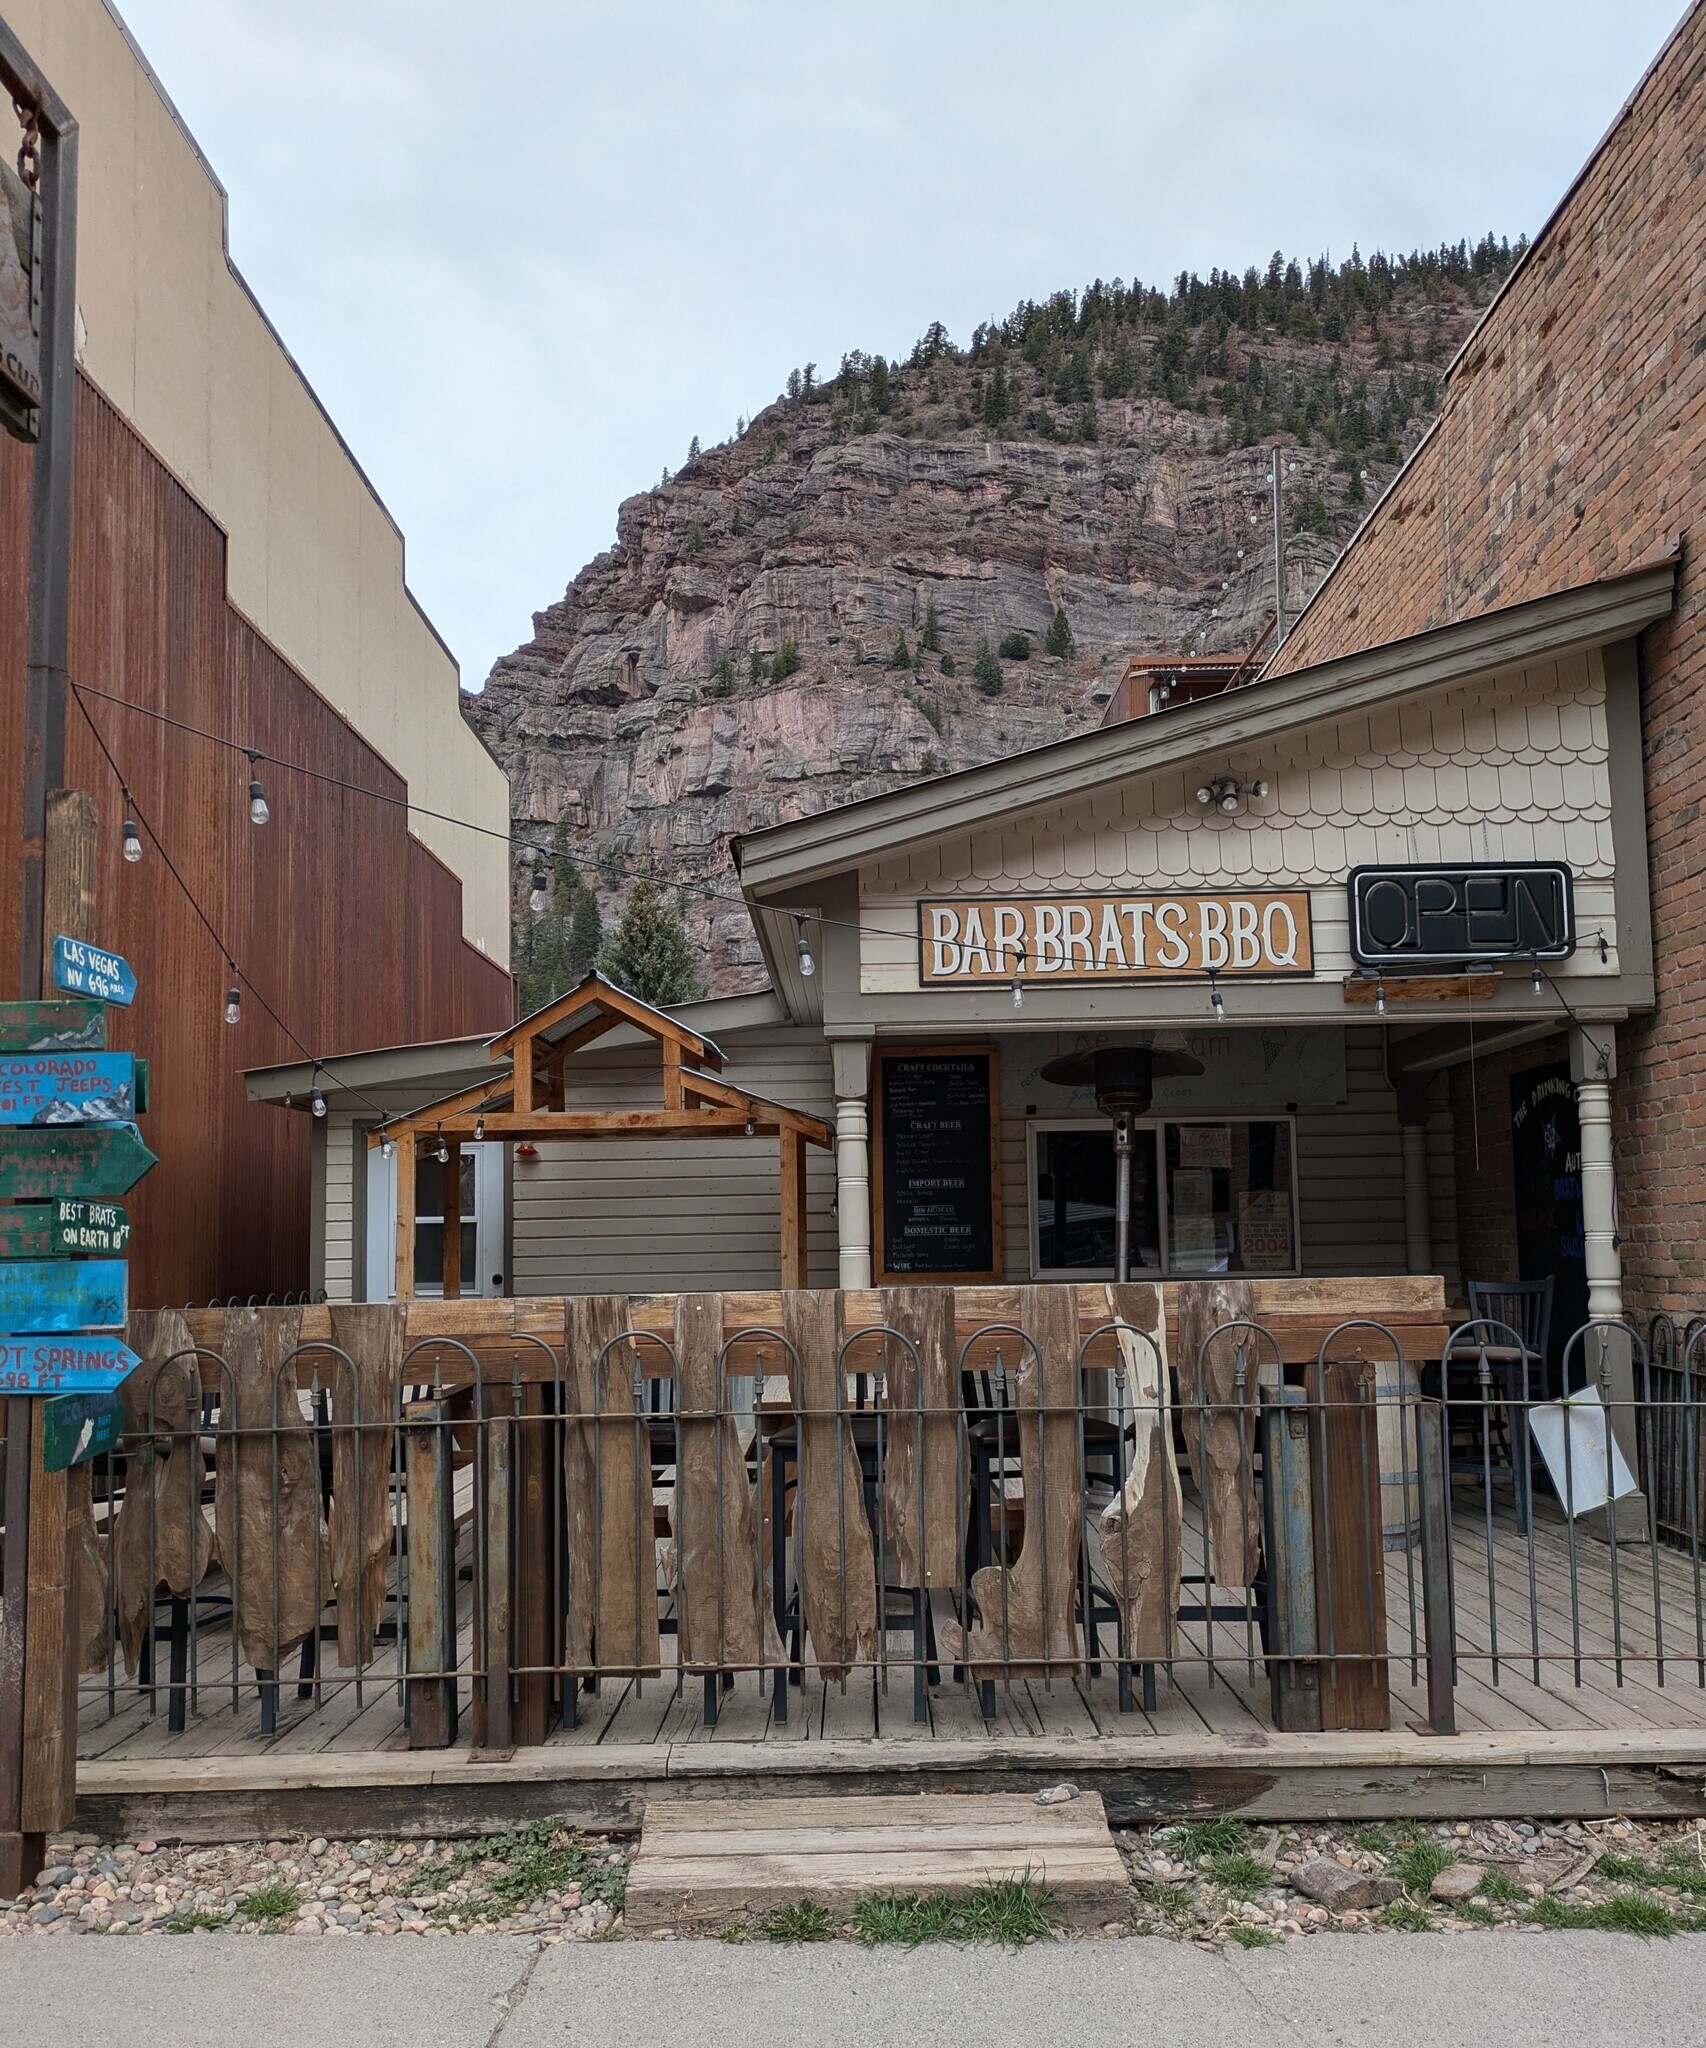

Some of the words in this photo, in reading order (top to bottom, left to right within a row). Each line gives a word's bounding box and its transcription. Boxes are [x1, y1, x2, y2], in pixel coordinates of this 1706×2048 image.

[1365, 879, 1558, 949] OPEN
[931, 907, 1025, 976] BAR
[1033, 902, 1189, 973] BRATS
[1197, 900, 1299, 969] BBQ
[64, 941, 85, 967] LAS
[88, 951, 120, 981] VEGAS
[67, 967, 83, 987] NV
[88, 973, 109, 997] 696
[110, 983, 125, 995] MILES
[897, 1063, 925, 1071] CRAFT
[926, 1063, 974, 1072] COCKTAILS
[0, 1079, 41, 1094] EST
[55, 1077, 112, 1094] JEEPS
[23, 1094, 43, 1107] FT
[1513, 1099, 1528, 1128] THE
[1531, 1077, 1571, 1107] DRINKING
[910, 1121, 939, 1129] CRAFT
[939, 1121, 962, 1129] BEER
[908, 1179, 941, 1187] IMPORT
[943, 1179, 965, 1187] BEER
[59, 1202, 84, 1221] BEST
[89, 1205, 117, 1228] BRATS
[63, 1228, 78, 1244] ON
[80, 1227, 109, 1249] EARTH
[112, 1231, 121, 1250] 18
[120, 1224, 130, 1239] FT
[904, 1226, 948, 1234] DOMESTIC
[949, 1226, 972, 1234] BEER
[1243, 1239, 1290, 1253] 2004
[893, 1262, 912, 1270] WINE
[33, 1346, 129, 1373] SPRINGS
[38, 1372, 67, 1389] FT
[95, 1428, 110, 1442] HERE
